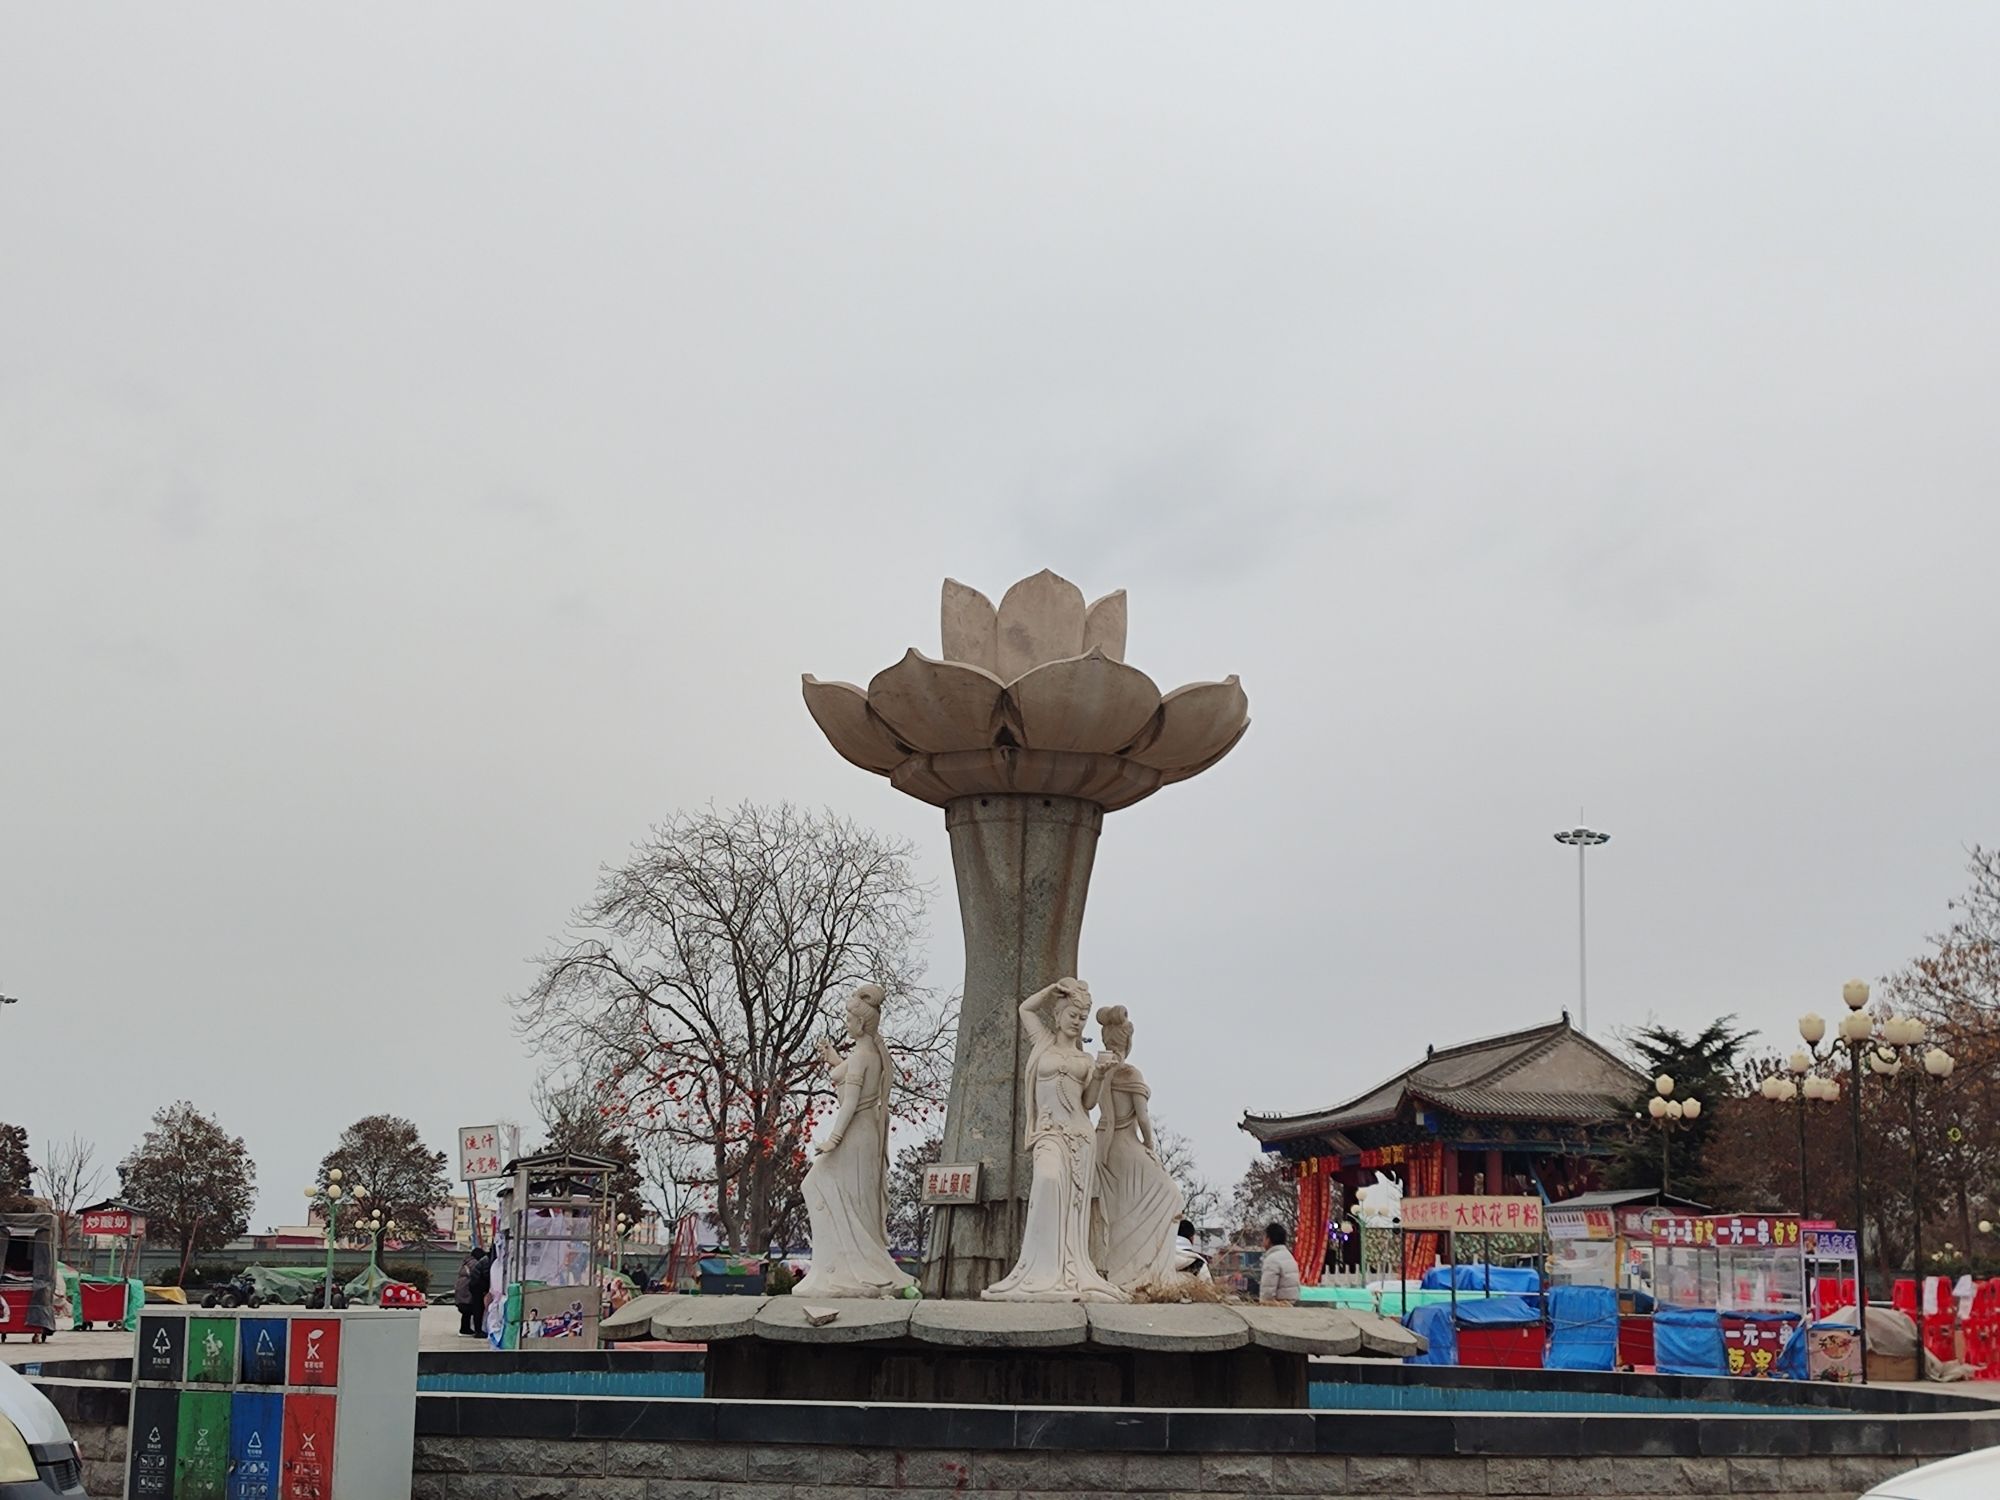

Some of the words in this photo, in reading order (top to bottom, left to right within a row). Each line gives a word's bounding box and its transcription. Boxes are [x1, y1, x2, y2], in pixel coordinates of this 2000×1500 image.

[928, 1172, 971, 1194] 禁止攀爬
[86, 1215, 128, 1229] 炒酸奶
[1455, 1202, 1539, 1228] 大虾花甲粉
